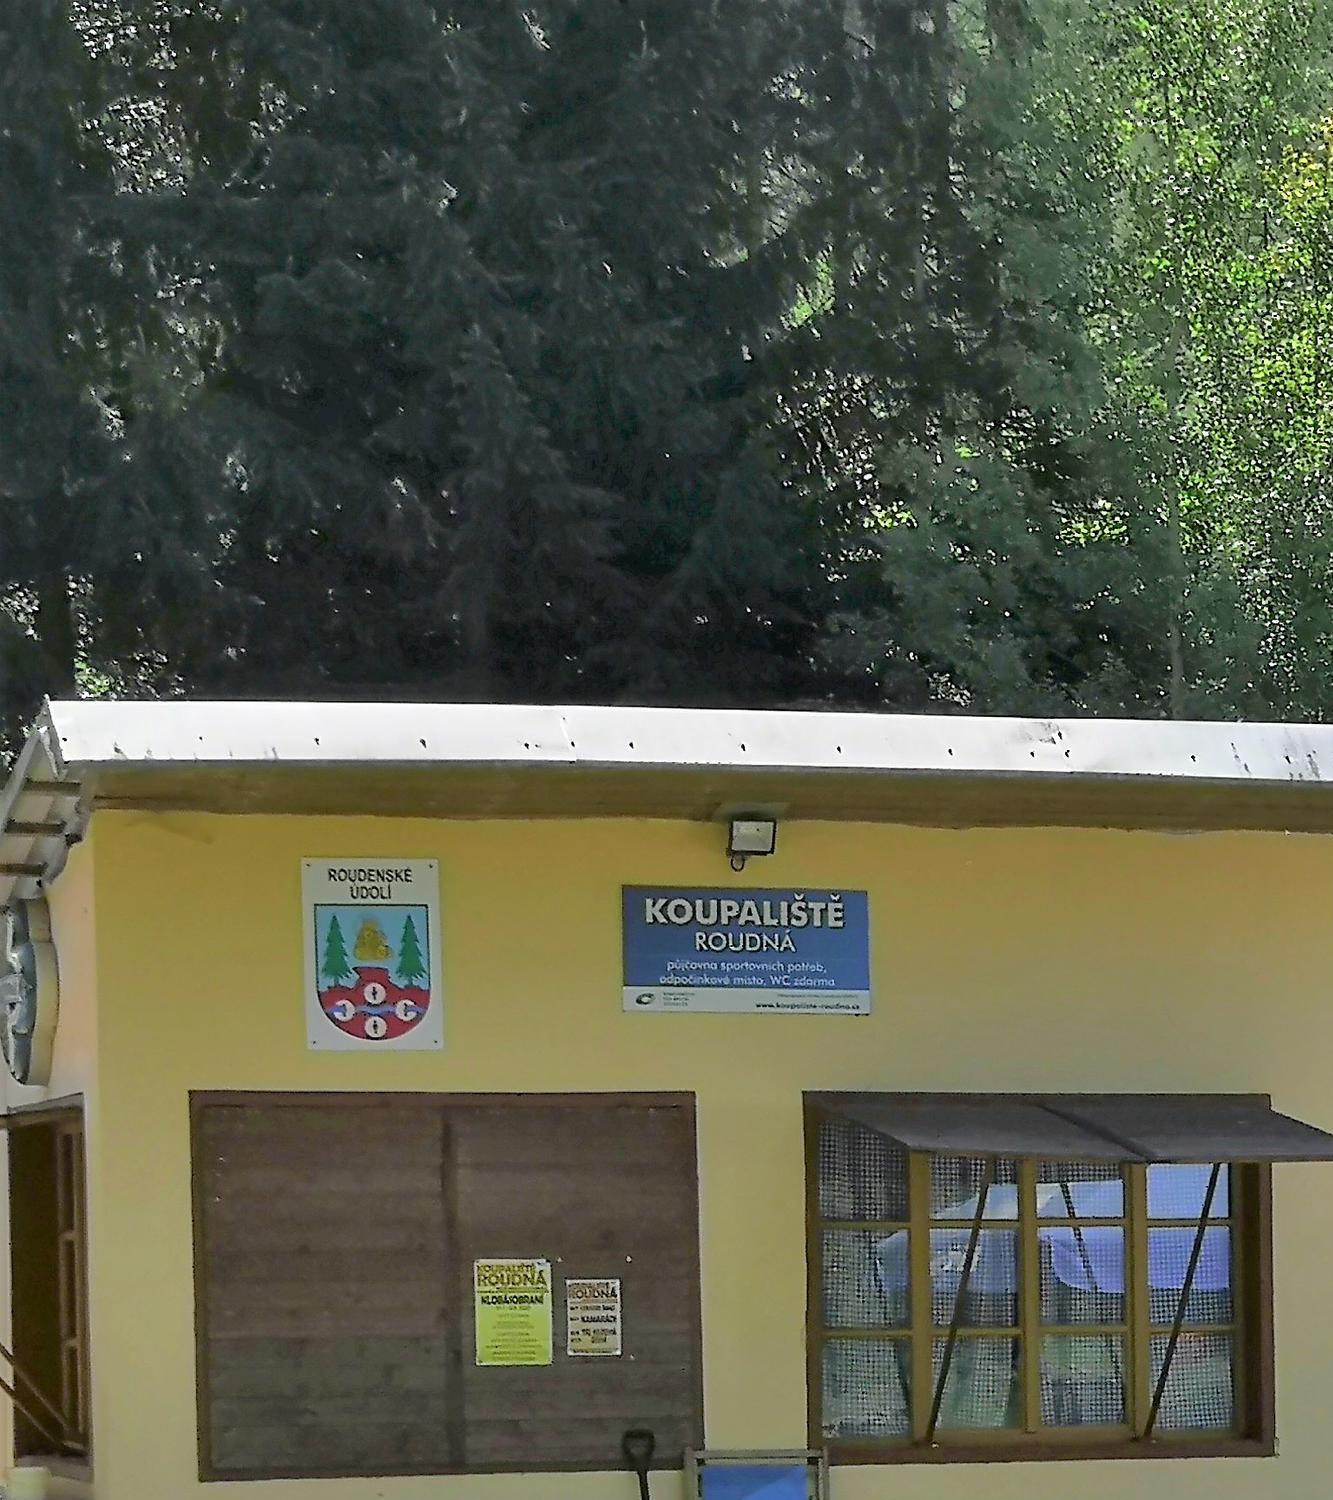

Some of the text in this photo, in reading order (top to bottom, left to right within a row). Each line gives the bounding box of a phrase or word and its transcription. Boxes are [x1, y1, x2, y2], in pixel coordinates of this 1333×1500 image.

[328, 867, 412, 882] ROUDENSKÉ
[350, 883, 391, 899] ÚDOLÍ
[644, 892, 846, 928] KOUPALIŠTĚ
[695, 929, 796, 953] ROUDNÁ
[667, 959, 827, 974] půjčovna sportovních potřeb,
[769, 975, 792, 986] WC
[793, 975, 836, 987] zdarma
[477, 1270, 548, 1287] ROUDNÁ
